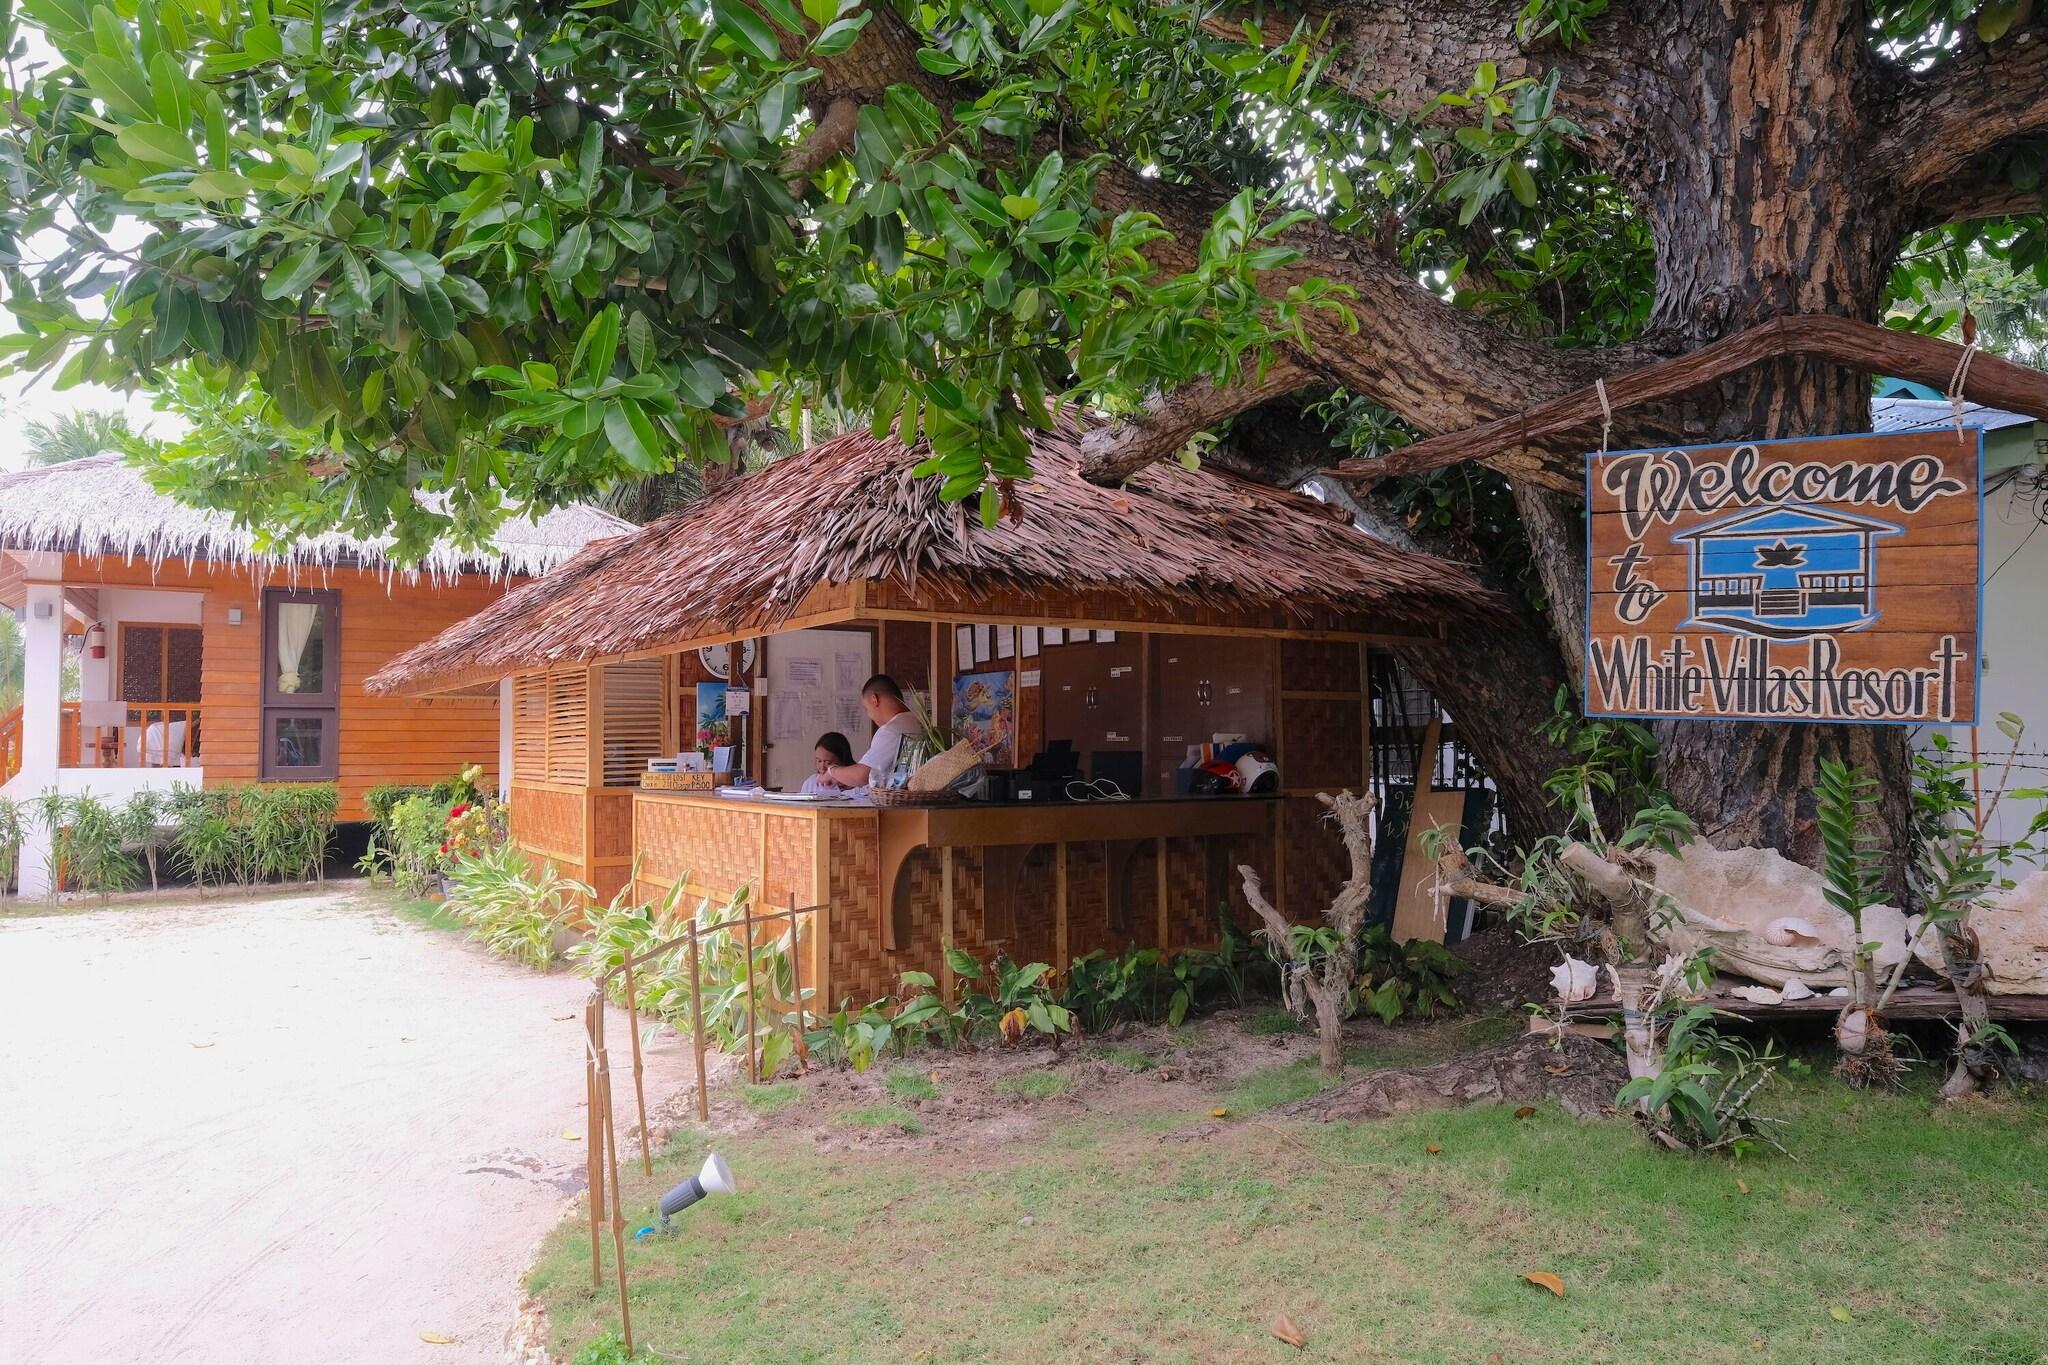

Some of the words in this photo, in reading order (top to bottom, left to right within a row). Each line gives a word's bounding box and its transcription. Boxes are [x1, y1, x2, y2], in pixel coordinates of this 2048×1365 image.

[1603, 446, 1966, 540] Welcome
[1608, 543, 1666, 624] to
[1591, 637, 1703, 712] White
[1704, 637, 1812, 714] Villas
[1812, 635, 1967, 720] Resort
